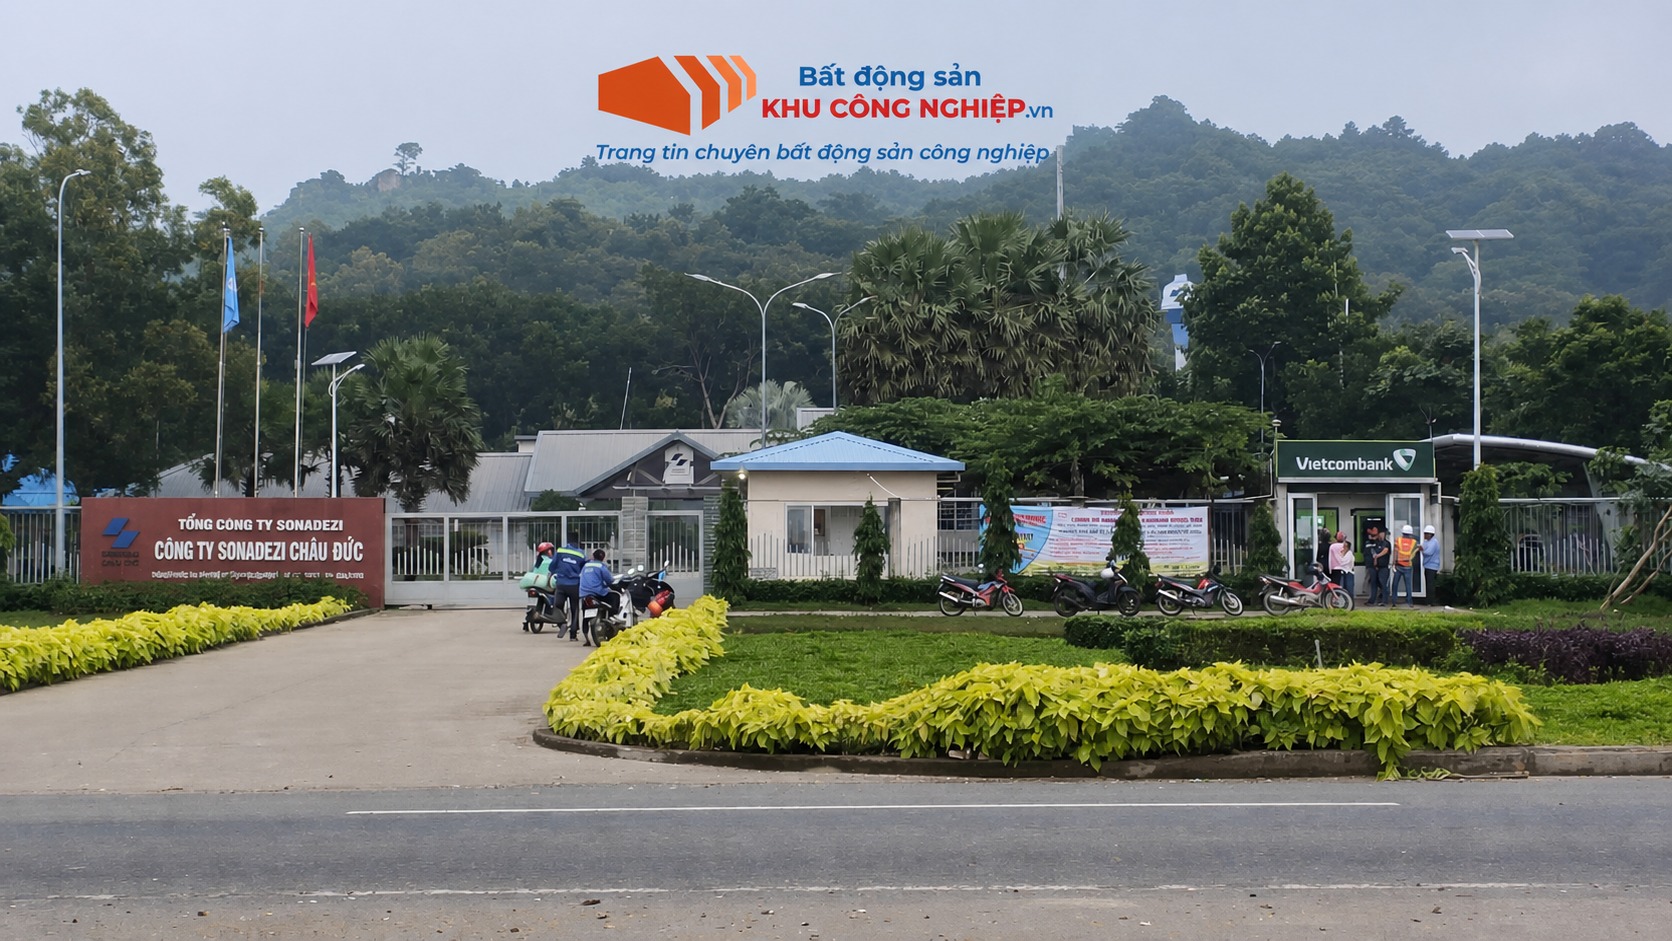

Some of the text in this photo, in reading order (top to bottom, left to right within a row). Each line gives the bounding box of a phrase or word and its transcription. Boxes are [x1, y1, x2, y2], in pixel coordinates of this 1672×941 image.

[1295, 456, 1394, 471] Vietcombank
[178, 513, 344, 531] TỔNG CÔNG TY SONADEZI
[154, 536, 364, 562] CÔNG TY SONADEZI CHÂU ĐỨC
